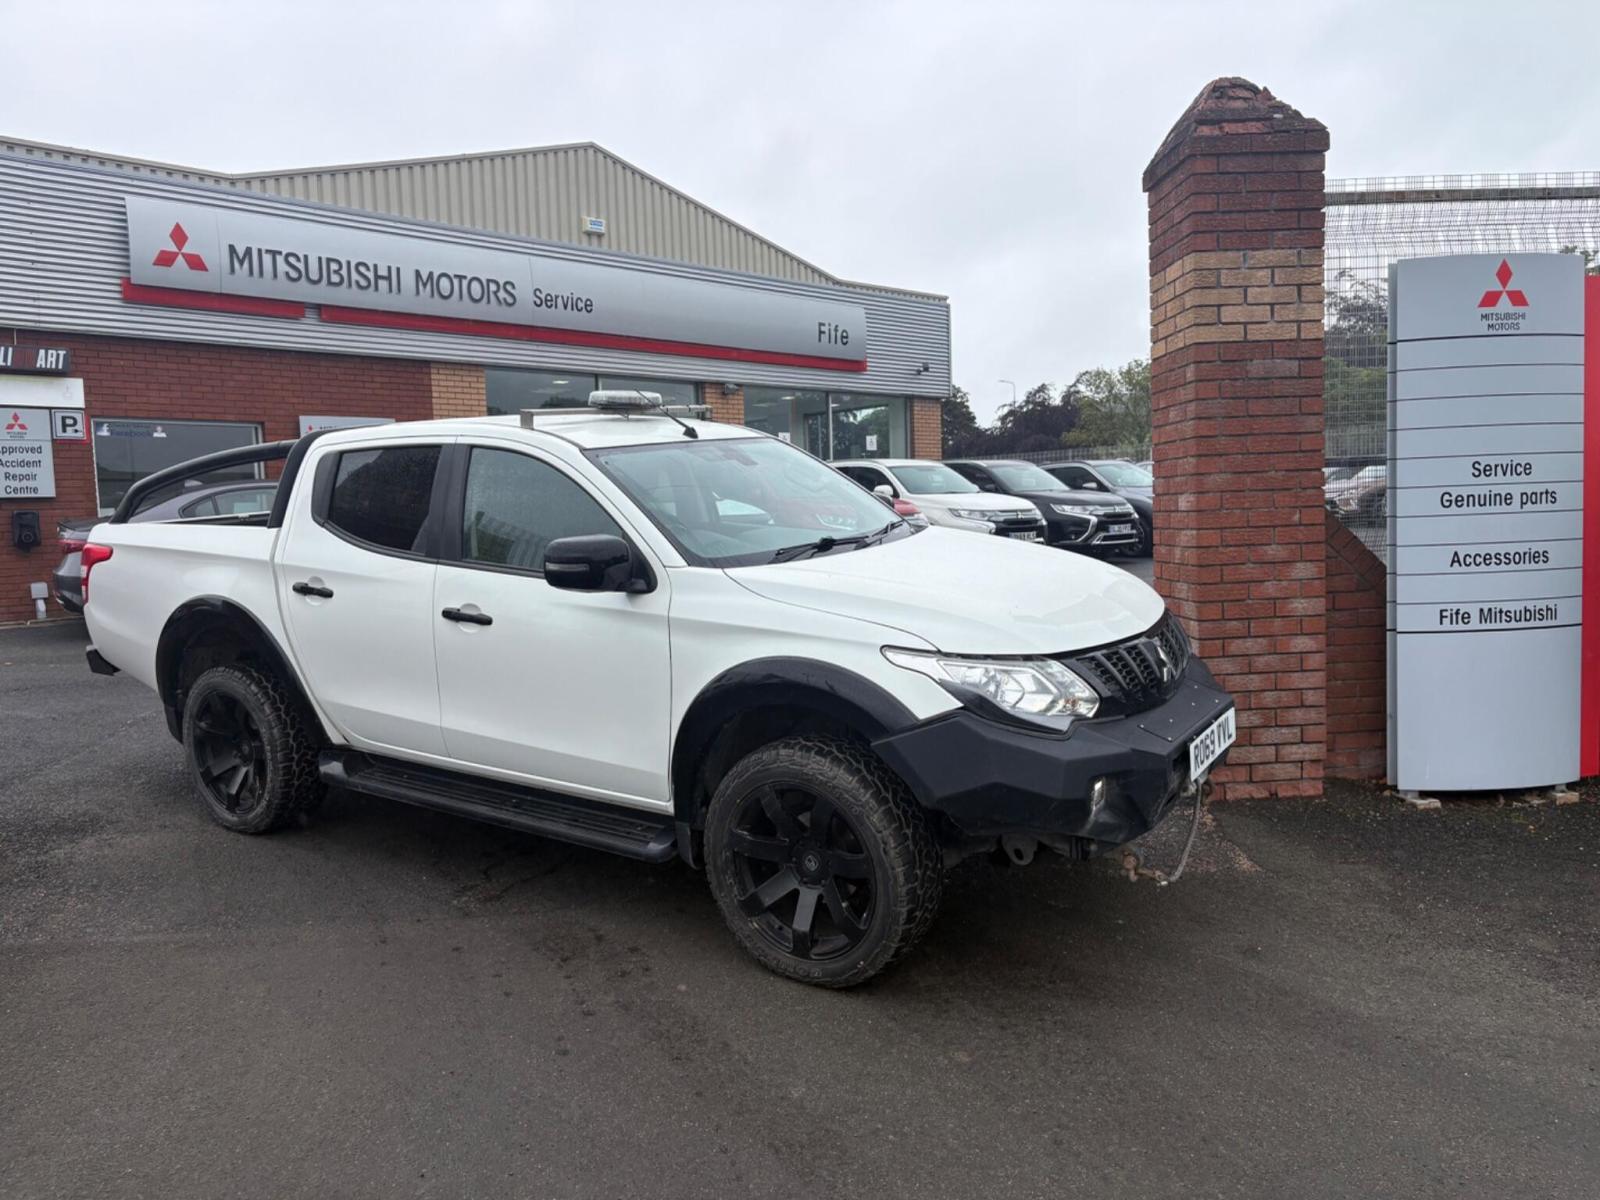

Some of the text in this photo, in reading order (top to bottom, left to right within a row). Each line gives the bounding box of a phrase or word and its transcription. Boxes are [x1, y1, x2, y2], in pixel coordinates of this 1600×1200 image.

[227, 244, 594, 314] MITSUBISHI MOTORS Service
[1480, 312, 1526, 321] MITSUBISHI
[818, 321, 849, 346] Fife
[1487, 322, 1520, 331] MOTORS
[36, 349, 67, 369] ART
[61, 415, 78, 433] P
[0, 445, 43, 456] pproved
[4, 472, 37, 483] Repair
[1471, 459, 1532, 478] Service
[4, 485, 39, 495] Centre
[1440, 489, 1557, 509] Genuine parts
[1450, 548, 1549, 568] Accessories
[1439, 604, 1558, 625] Fife Mitsubishi
